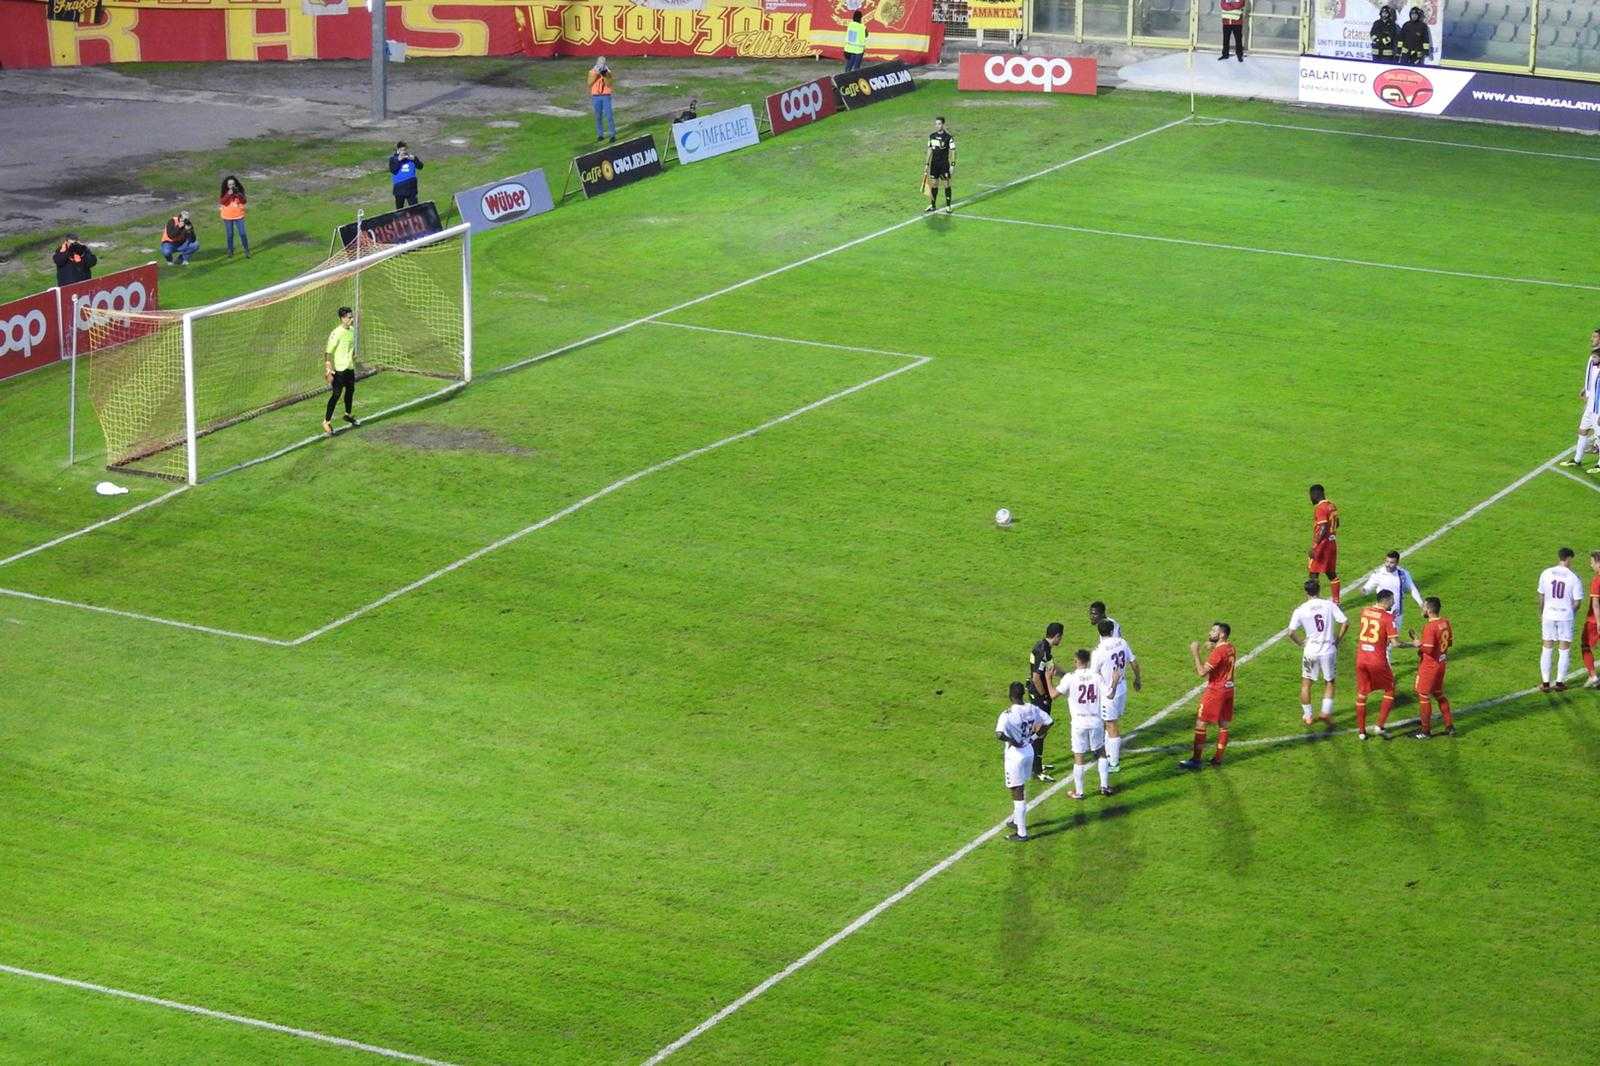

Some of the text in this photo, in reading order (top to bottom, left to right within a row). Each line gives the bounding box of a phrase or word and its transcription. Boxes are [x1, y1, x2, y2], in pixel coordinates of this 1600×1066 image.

[869, 70, 912, 91] GUGLIELMO
[1342, 72, 1367, 84] VITO
[612, 148, 659, 175] GUGLIELMO
[485, 188, 526, 215] Wüber
[1550, 579, 1566, 600] 10
[1314, 613, 1325, 632] 6
[1359, 616, 1380, 644] 23
[1439, 630, 1450, 653] 8
[1110, 649, 1127, 672] 33
[1077, 683, 1098, 704] 24
